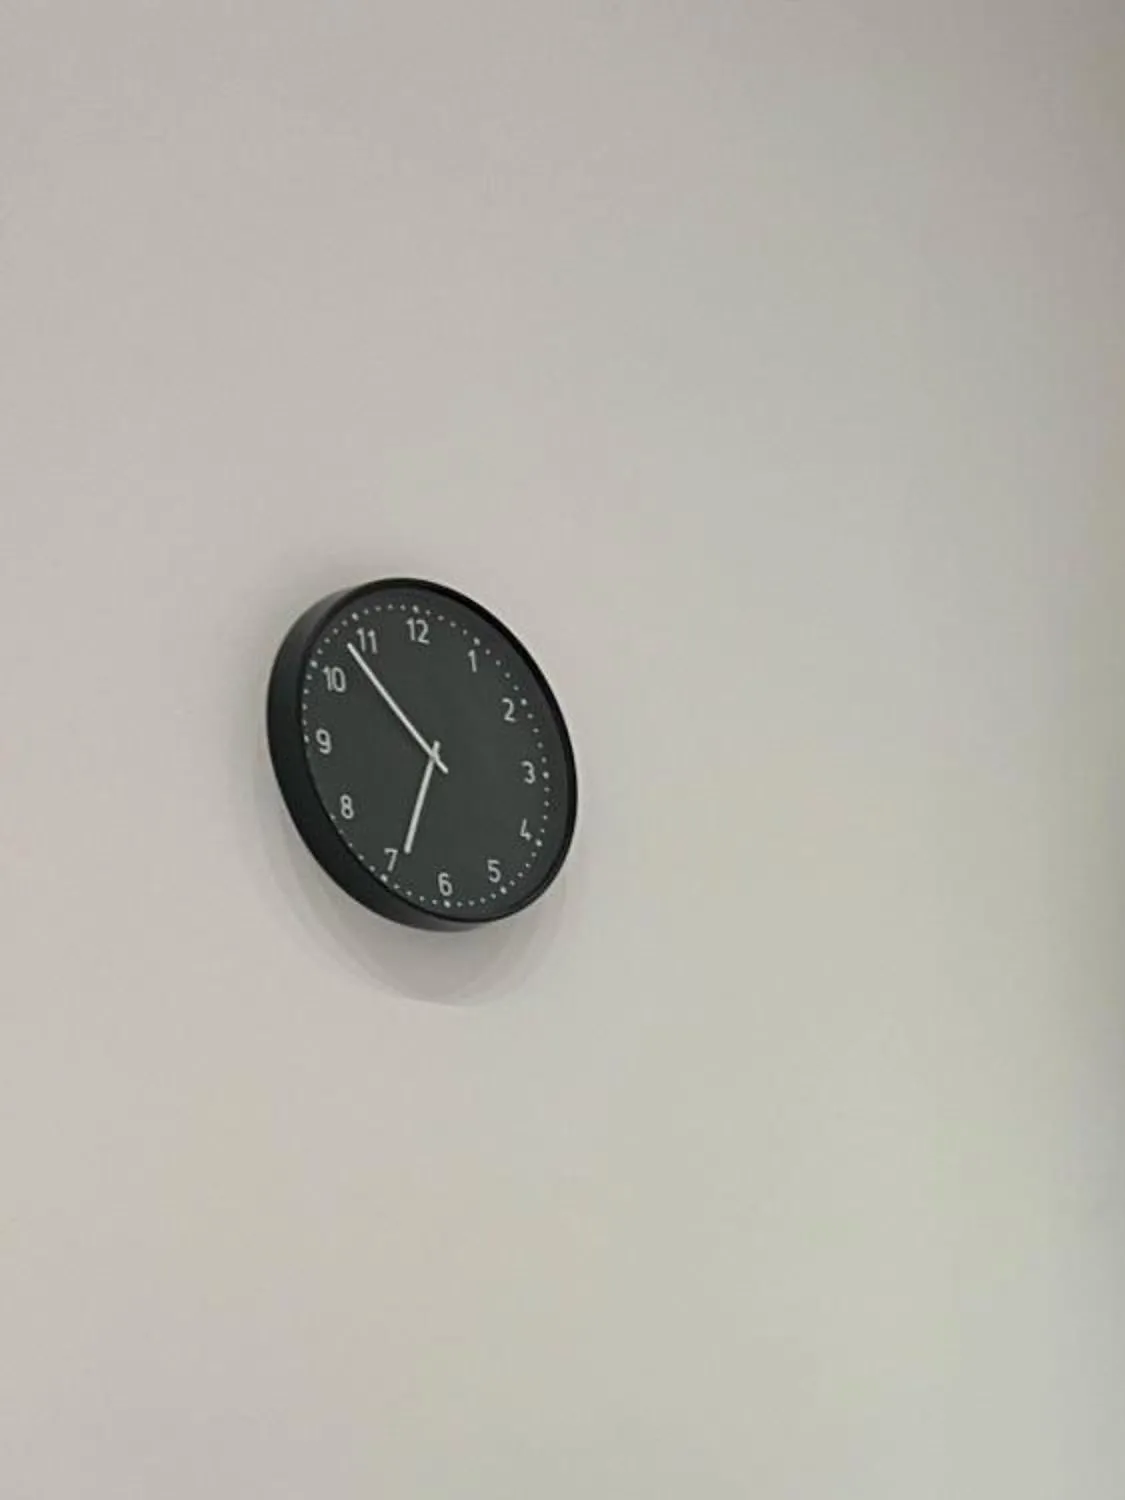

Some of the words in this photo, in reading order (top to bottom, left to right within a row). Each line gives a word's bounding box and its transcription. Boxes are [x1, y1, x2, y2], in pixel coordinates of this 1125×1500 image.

[356, 628, 378, 654] 11
[406, 618, 430, 644] 12
[468, 650, 478, 673] 1
[323, 667, 346, 693] 10
[502, 698, 516, 723] 2
[316, 729, 332, 755] 9
[521, 761, 536, 784] 3
[340, 795, 354, 819] 8
[520, 818, 531, 841] 4
[384, 848, 398, 872] 7
[488, 859, 500, 883] 5
[438, 872, 453, 897] 6
